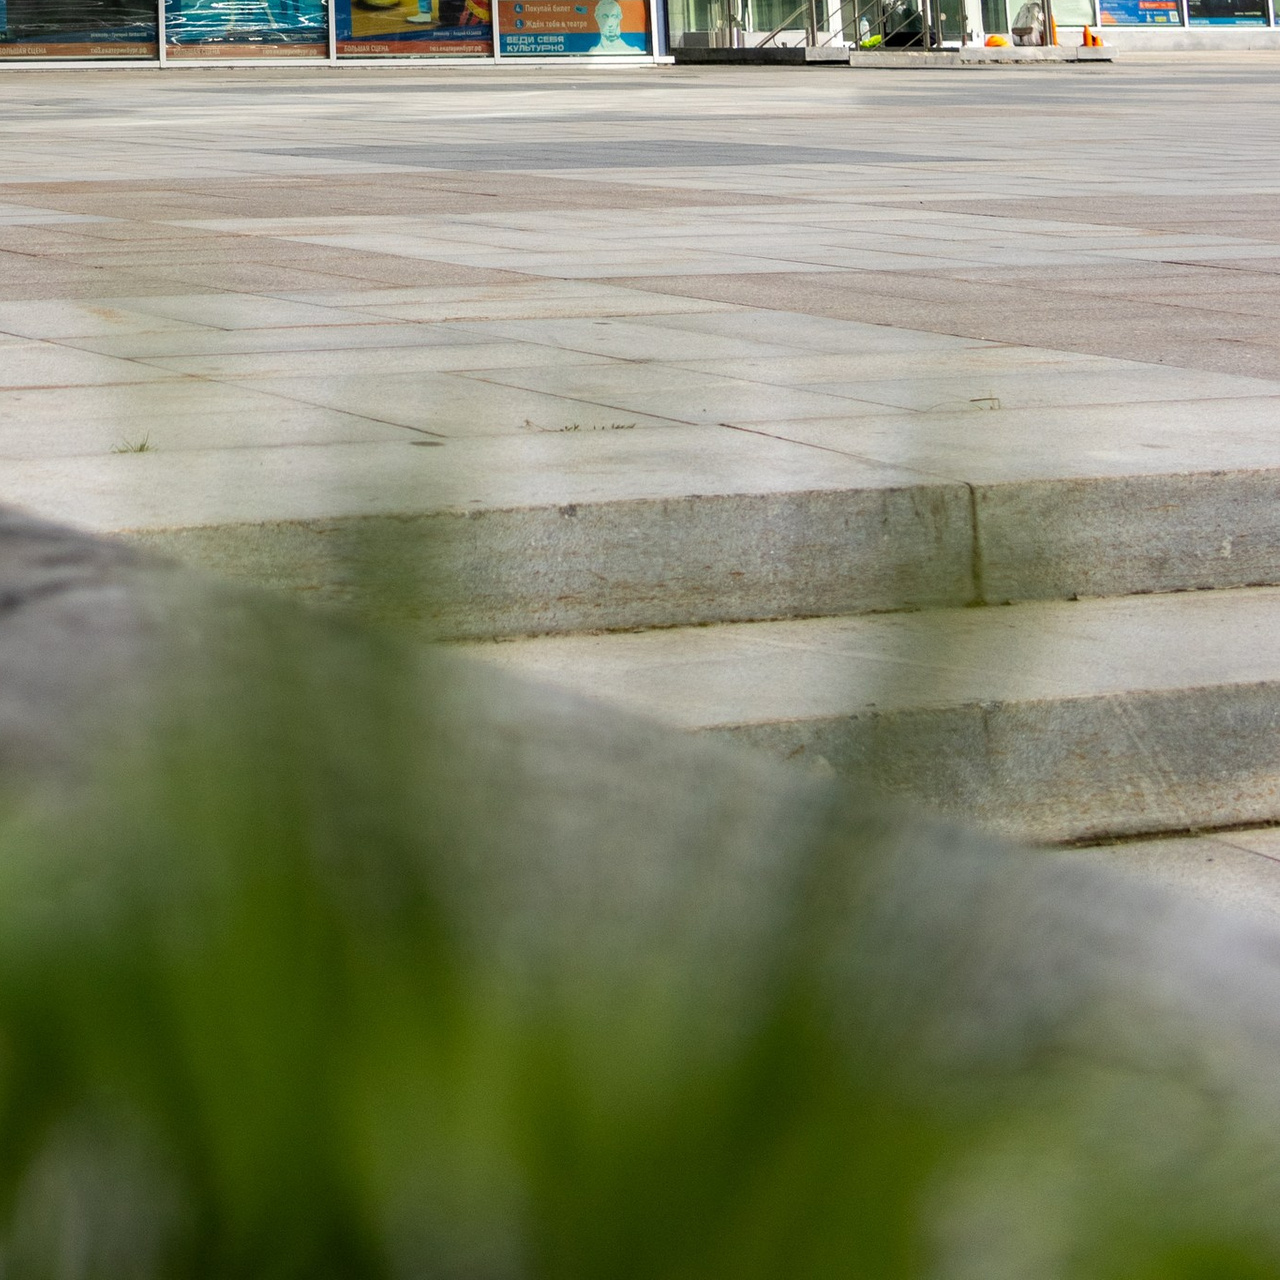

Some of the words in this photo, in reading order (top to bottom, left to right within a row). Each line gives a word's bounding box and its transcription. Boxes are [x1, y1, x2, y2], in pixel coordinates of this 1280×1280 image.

[525, 4, 552, 13] Покупай
[552, 4, 570, 12] билет
[506, 35, 535, 44] ВЕДИ
[27, 47, 48, 55] СЦЕНА
[506, 44, 565, 52] КУЛЬТУРНО
